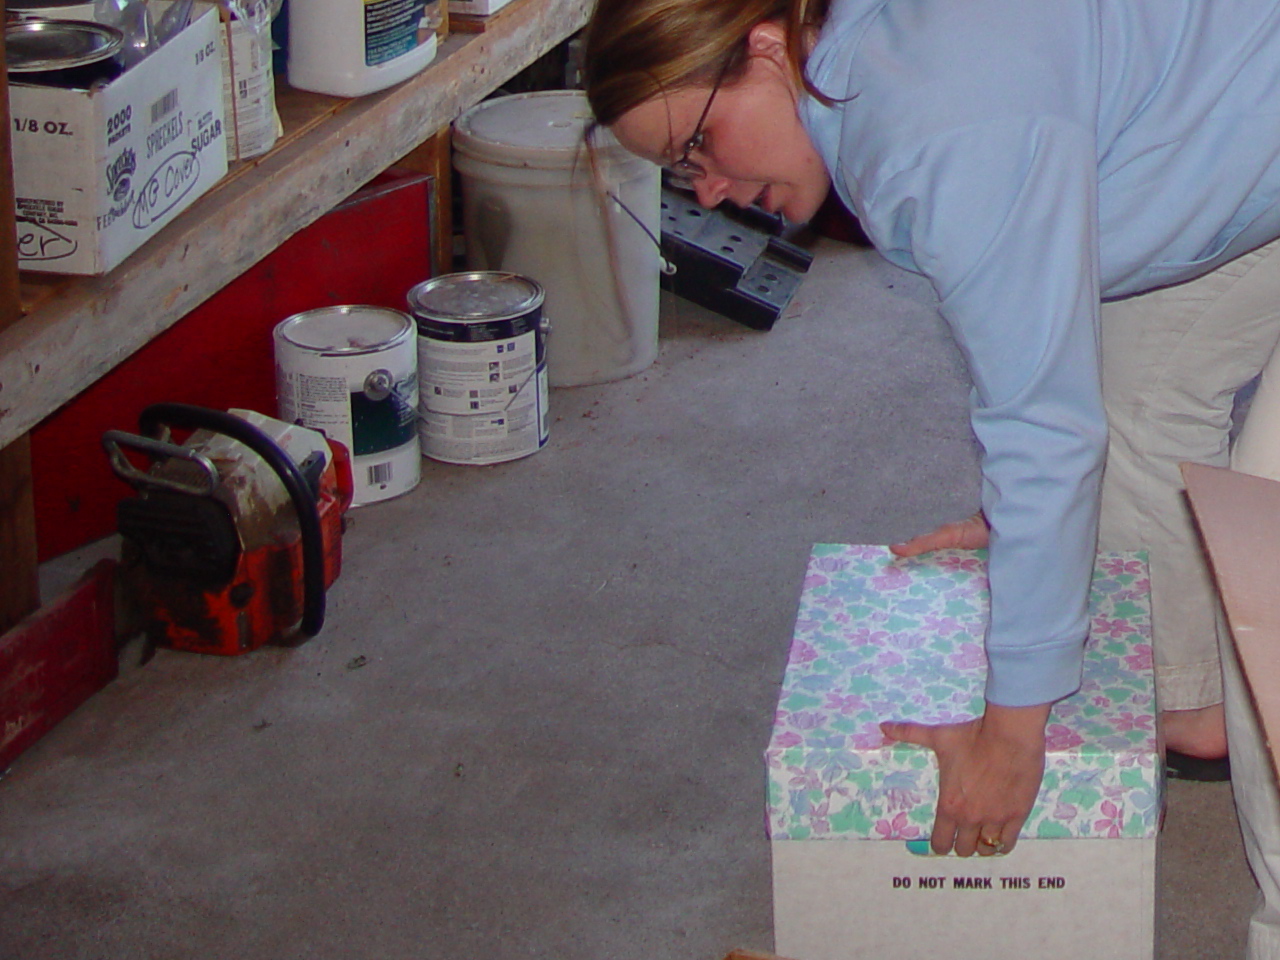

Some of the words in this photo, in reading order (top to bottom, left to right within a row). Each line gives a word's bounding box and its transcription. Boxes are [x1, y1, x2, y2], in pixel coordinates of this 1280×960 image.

[14, 117, 39, 133] 1/8
[43, 120, 73, 136] OZ.
[107, 104, 132, 136] 2000
[146, 110, 184, 159] SPRECKELS
[191, 118, 222, 153] SUGAR
[892, 876, 912, 890] DO
[918, 876, 947, 890] NOT
[953, 876, 993, 890] MARK
[1000, 876, 1032, 890] THIS
[1037, 876, 1066, 890] END
